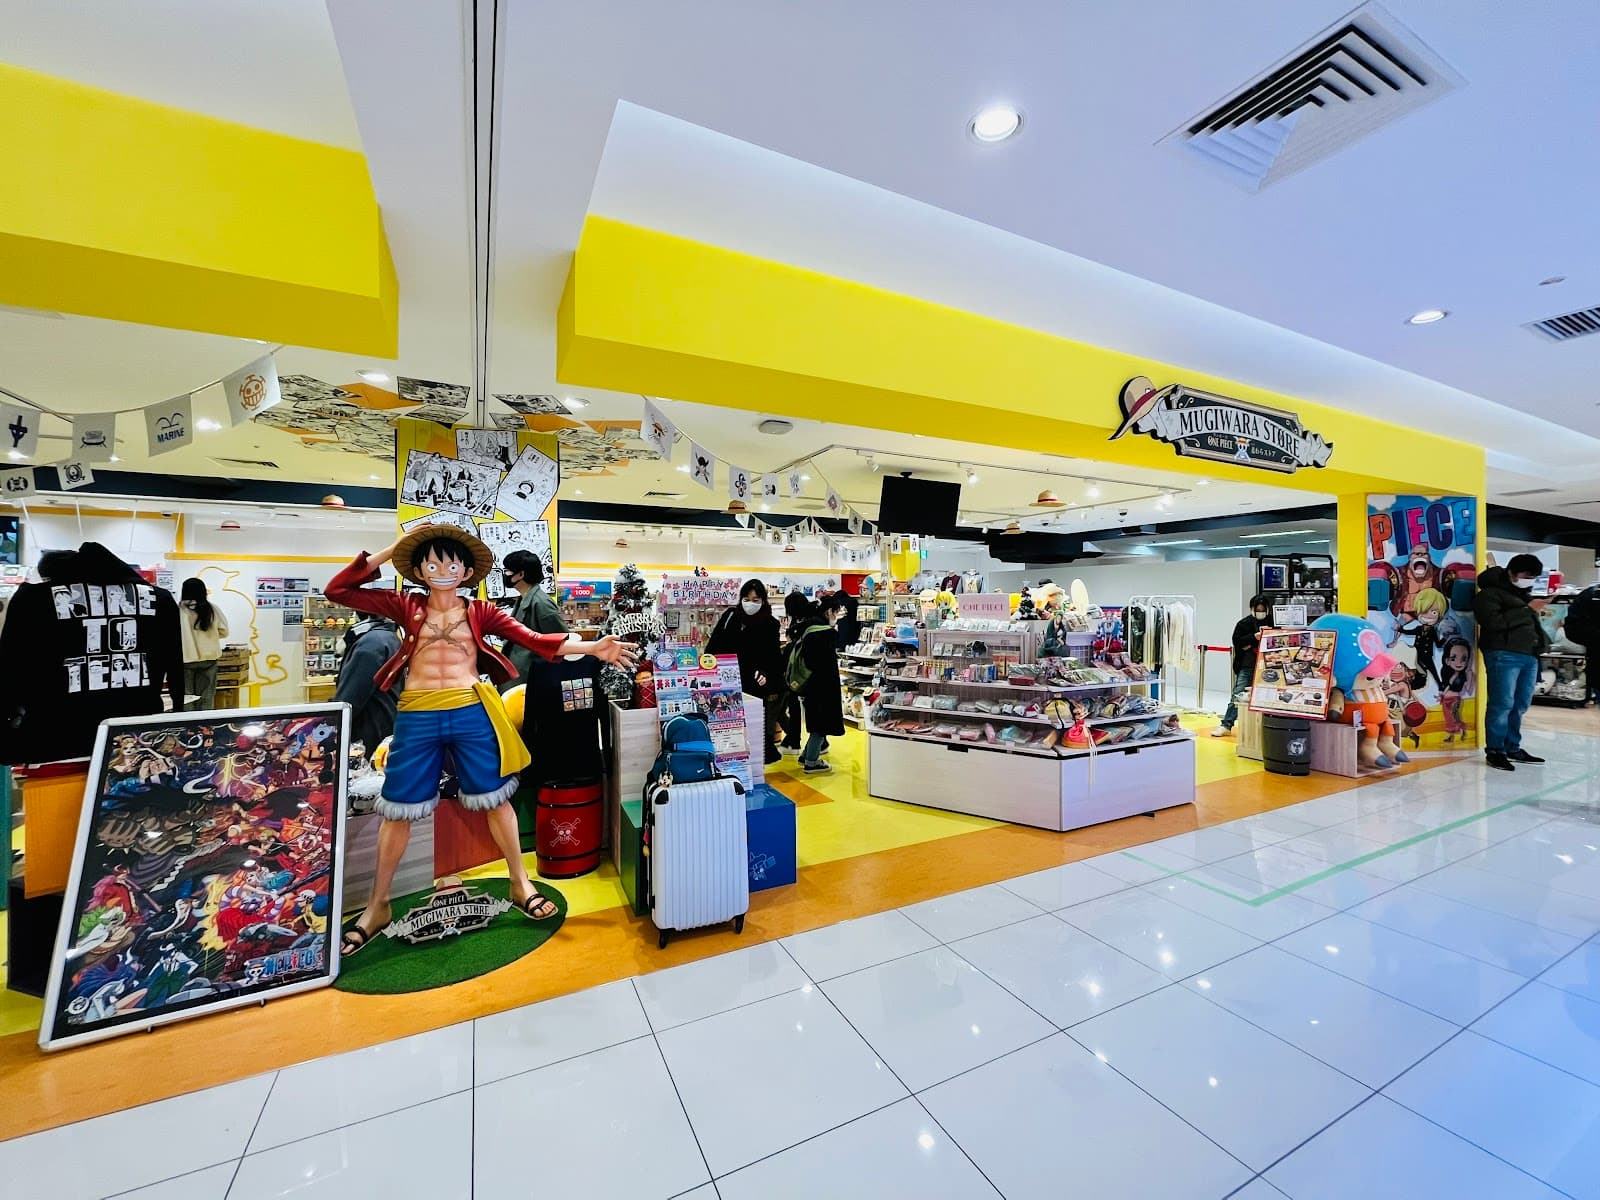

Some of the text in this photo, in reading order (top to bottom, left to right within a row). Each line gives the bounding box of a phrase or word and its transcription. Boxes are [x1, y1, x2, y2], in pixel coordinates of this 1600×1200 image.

[157, 428, 184, 442] MARINE
[1179, 408, 1299, 457] MUGIWARA STORE
[1207, 435, 1220, 448] ONE
[1220, 439, 1234, 450] PIECE
[1368, 500, 1475, 560] PIECE
[683, 580, 724, 588] HAPPY
[51, 583, 157, 620] NINE
[673, 590, 736, 600] BIRTHDAY
[619, 612, 659, 625] MERRY
[83, 617, 137, 653] TO
[611, 620, 667, 637] CHRISTMAS
[433, 894, 465, 908] ONE PIECE
[410, 906, 462, 931] MUGIWARA
[463, 904, 490, 915] STORE
